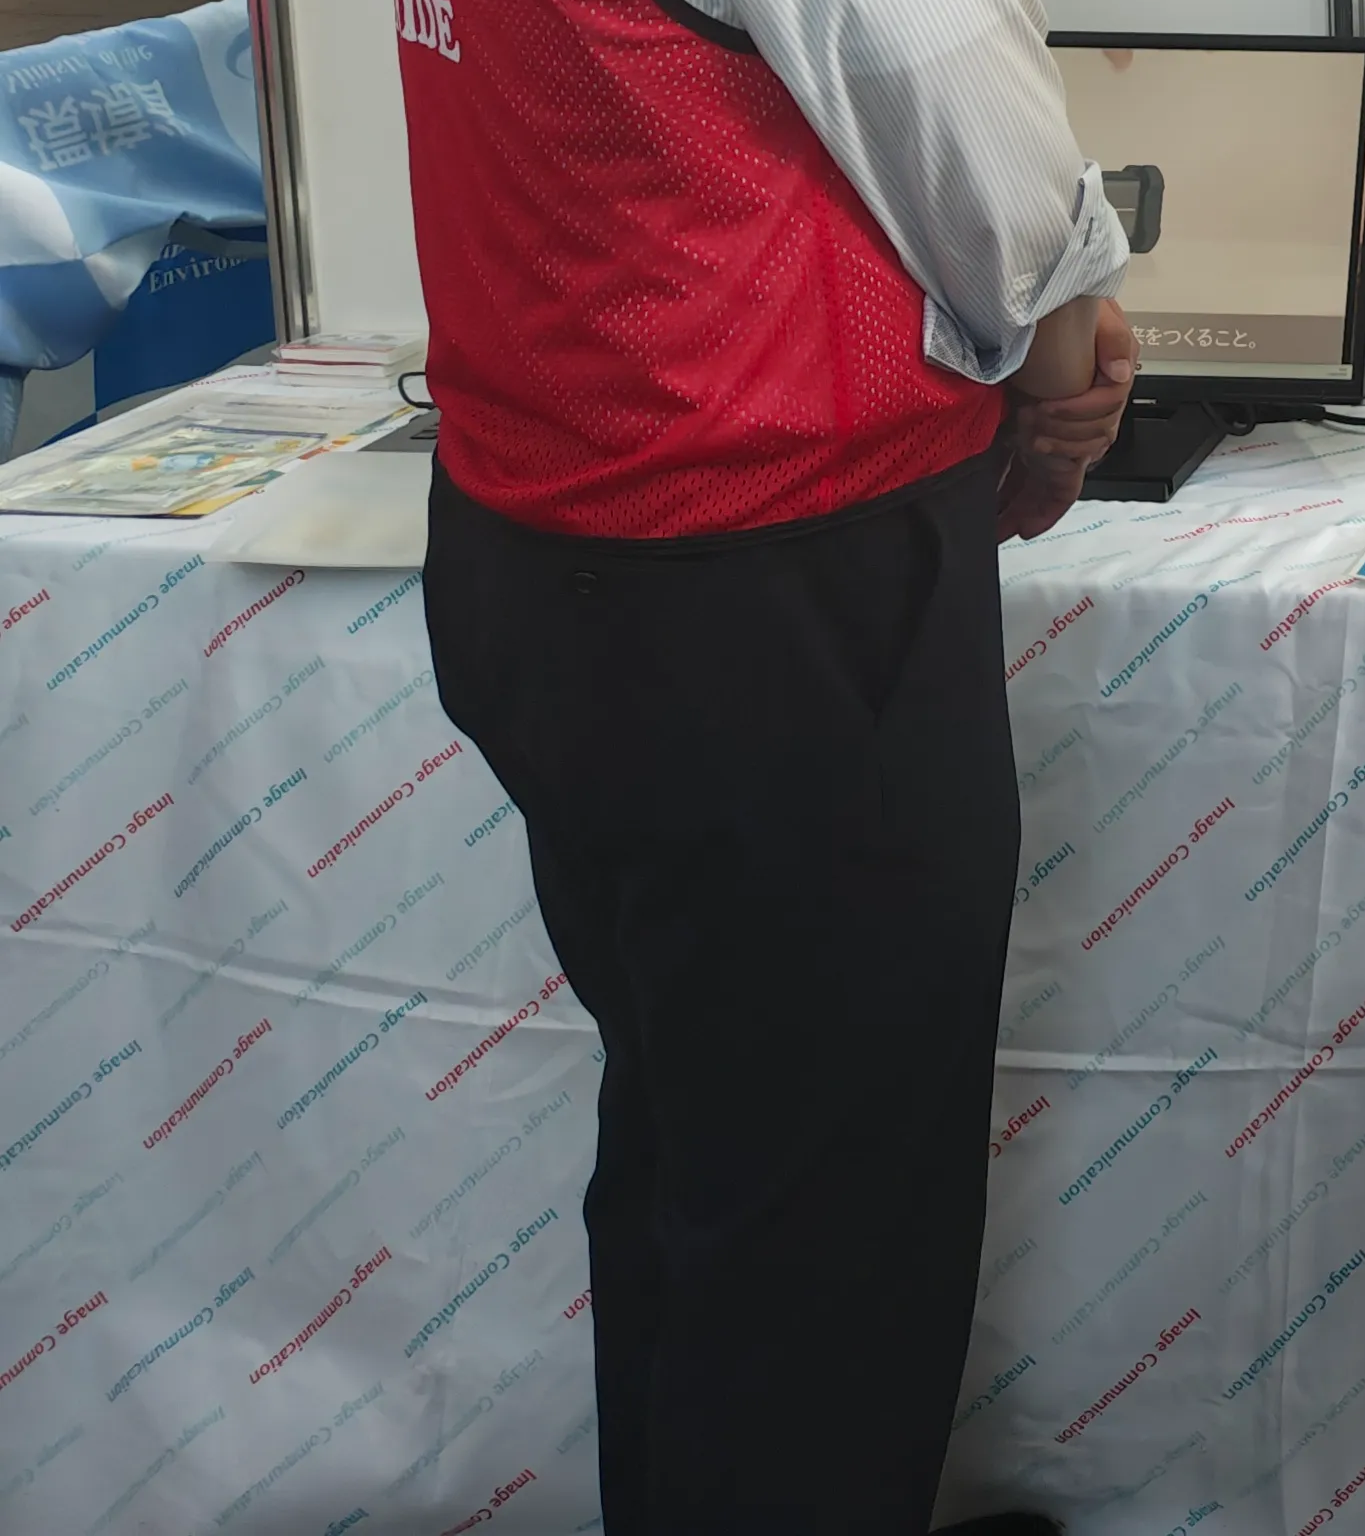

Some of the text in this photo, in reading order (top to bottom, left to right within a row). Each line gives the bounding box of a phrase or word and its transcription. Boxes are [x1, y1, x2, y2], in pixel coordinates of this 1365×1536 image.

[46, 553, 206, 691] Image Communication
[306, 740, 464, 880] Image Communication
[1080, 796, 1236, 952] Image Communication
[1224, 1044, 1335, 1159] Communication
